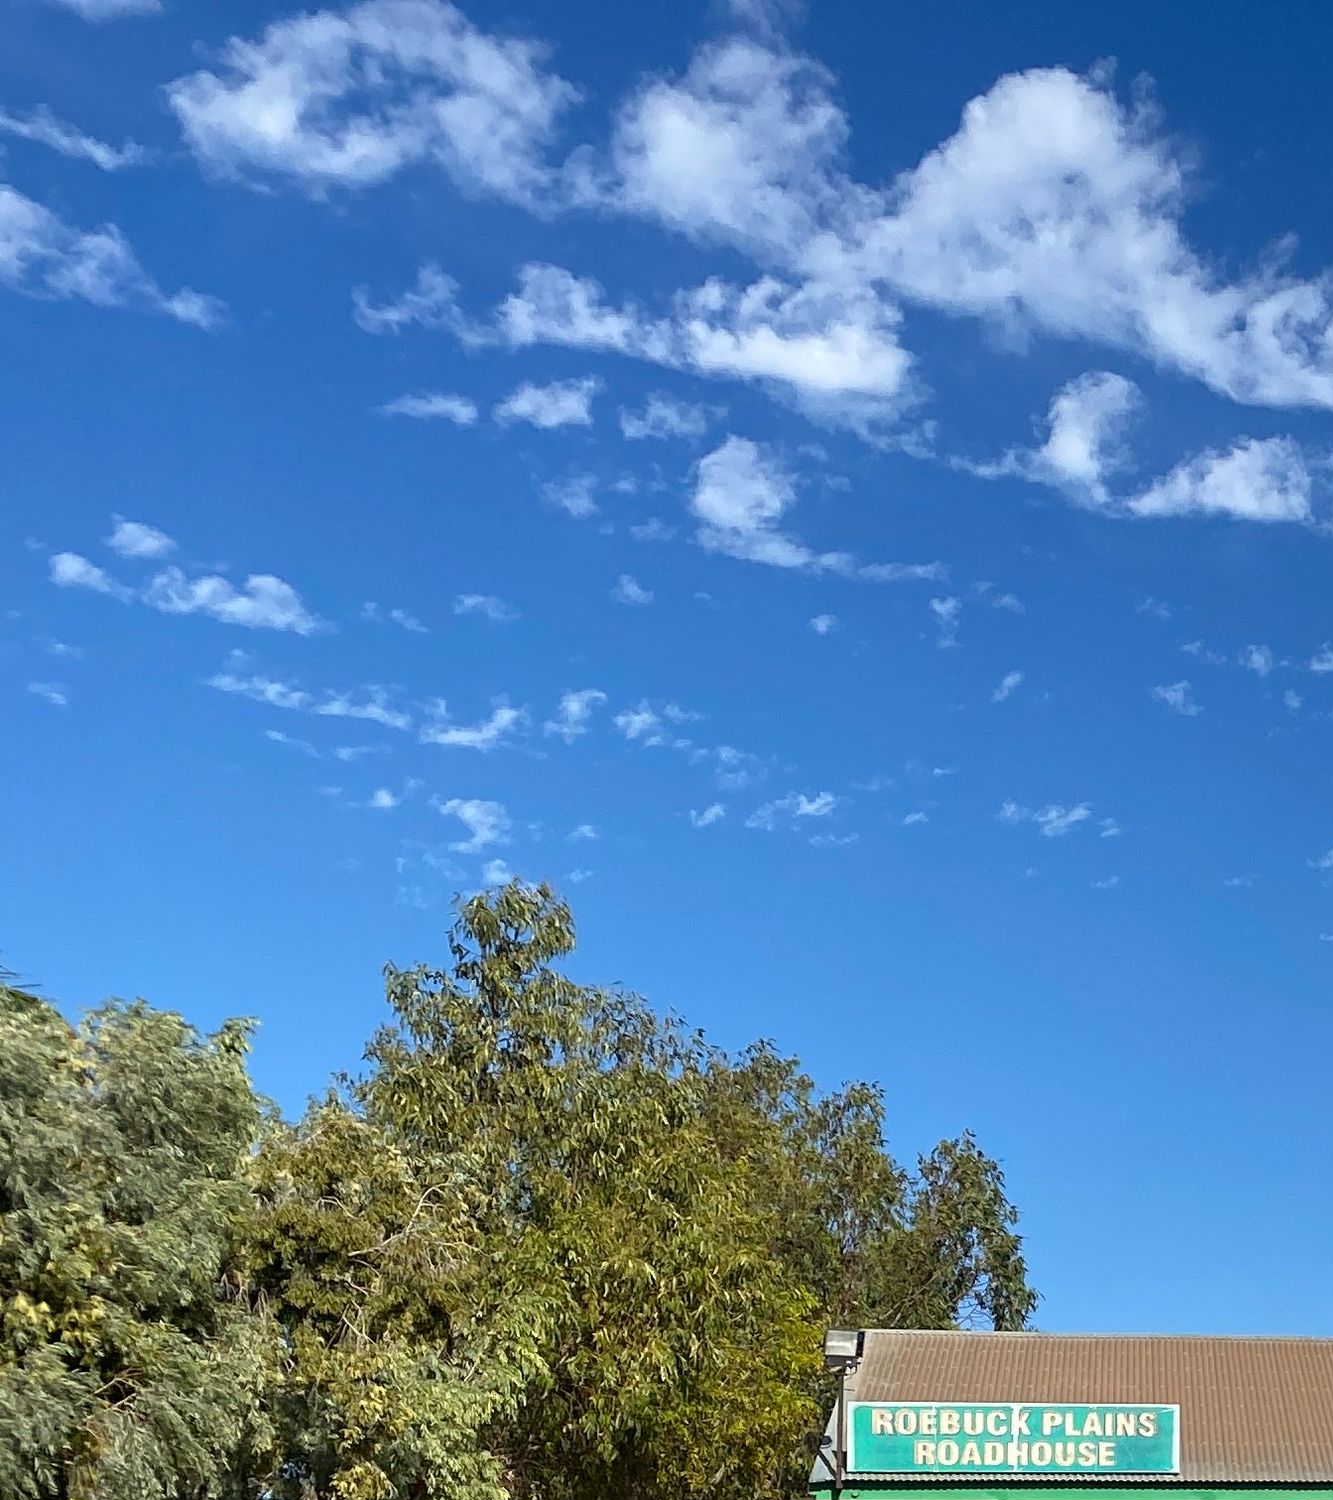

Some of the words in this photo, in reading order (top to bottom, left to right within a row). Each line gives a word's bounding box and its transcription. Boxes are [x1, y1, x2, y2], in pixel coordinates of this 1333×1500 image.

[872, 1408, 1031, 1435] ROEBUCK
[1043, 1410, 1156, 1437] PLAINS
[915, 1440, 1115, 1466] ROADHOUSE
